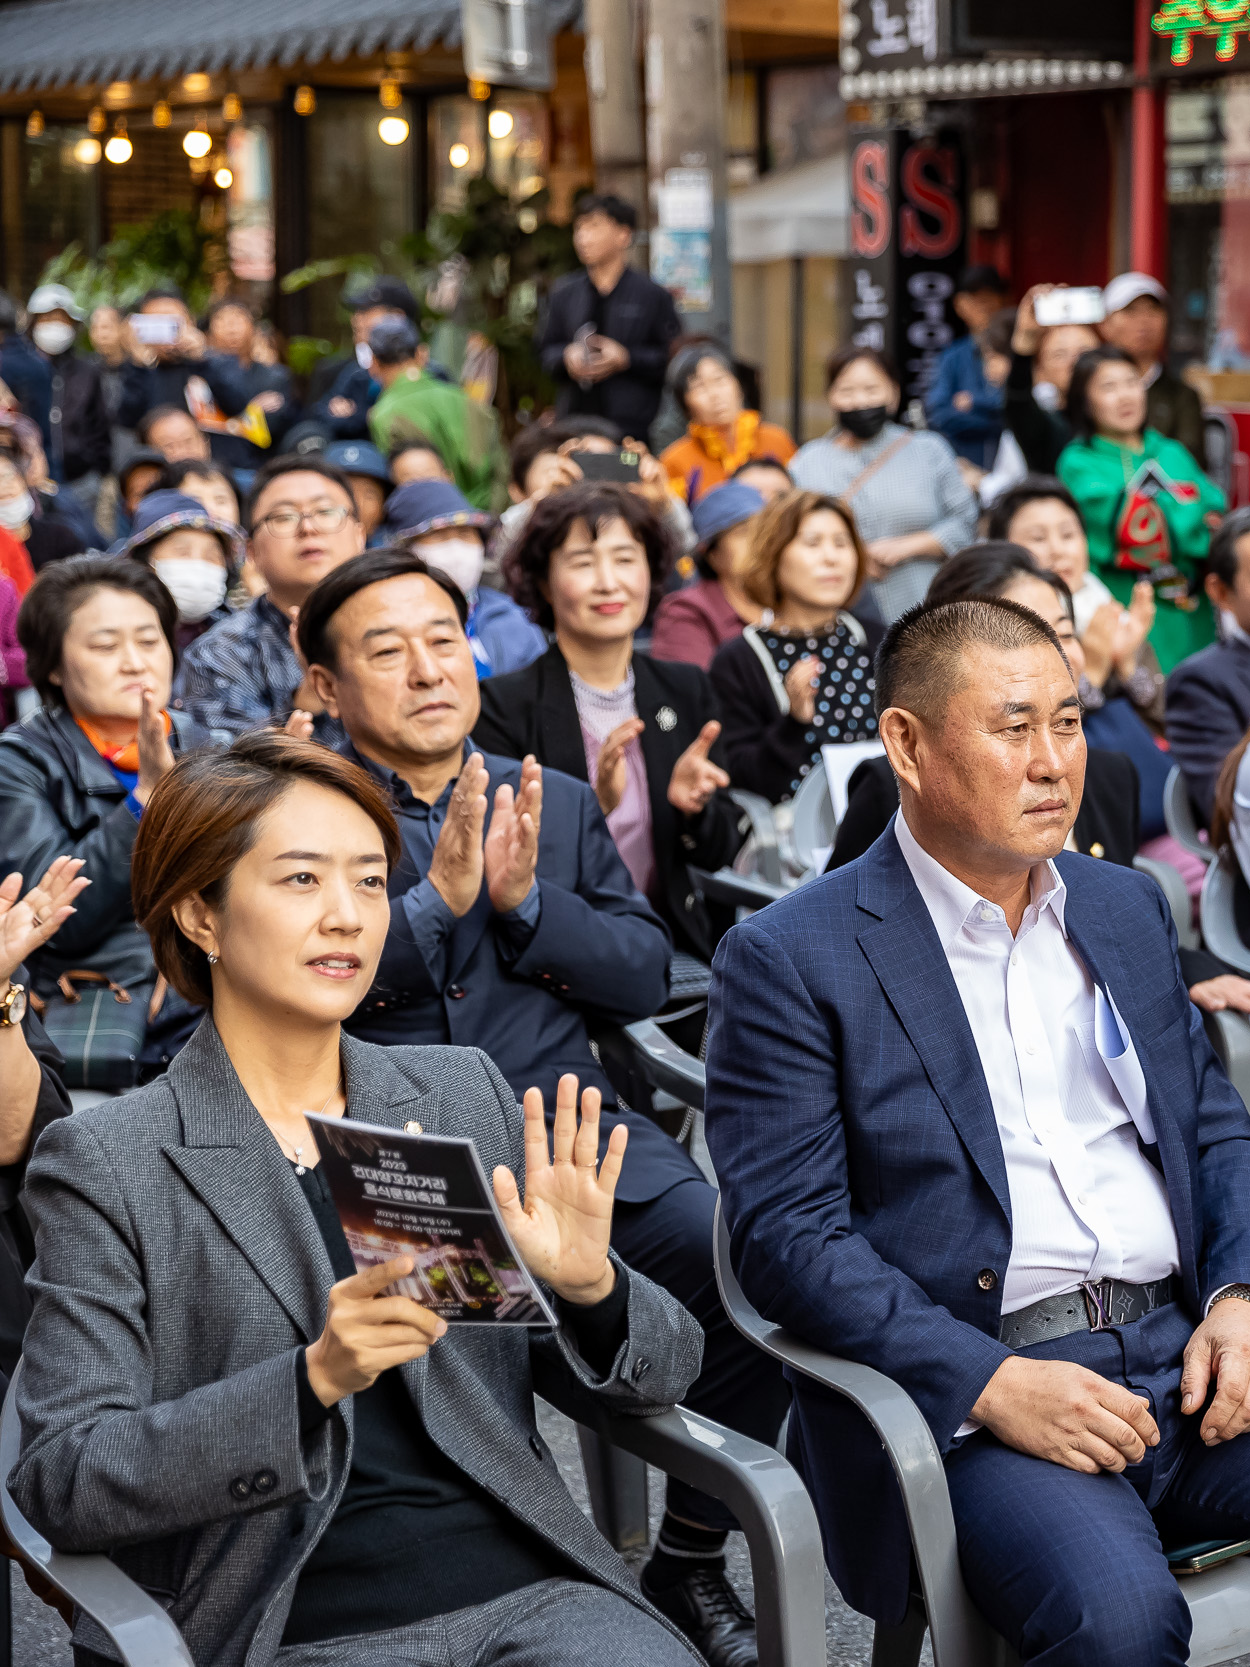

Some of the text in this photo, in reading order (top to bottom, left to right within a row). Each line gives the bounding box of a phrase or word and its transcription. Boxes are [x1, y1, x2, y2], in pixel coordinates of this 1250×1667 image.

[851, 140, 892, 259] S
[901, 140, 961, 259] S
[364, 1182, 447, 1205] 음식문화축제
[379, 1160, 408, 1171] 2023
